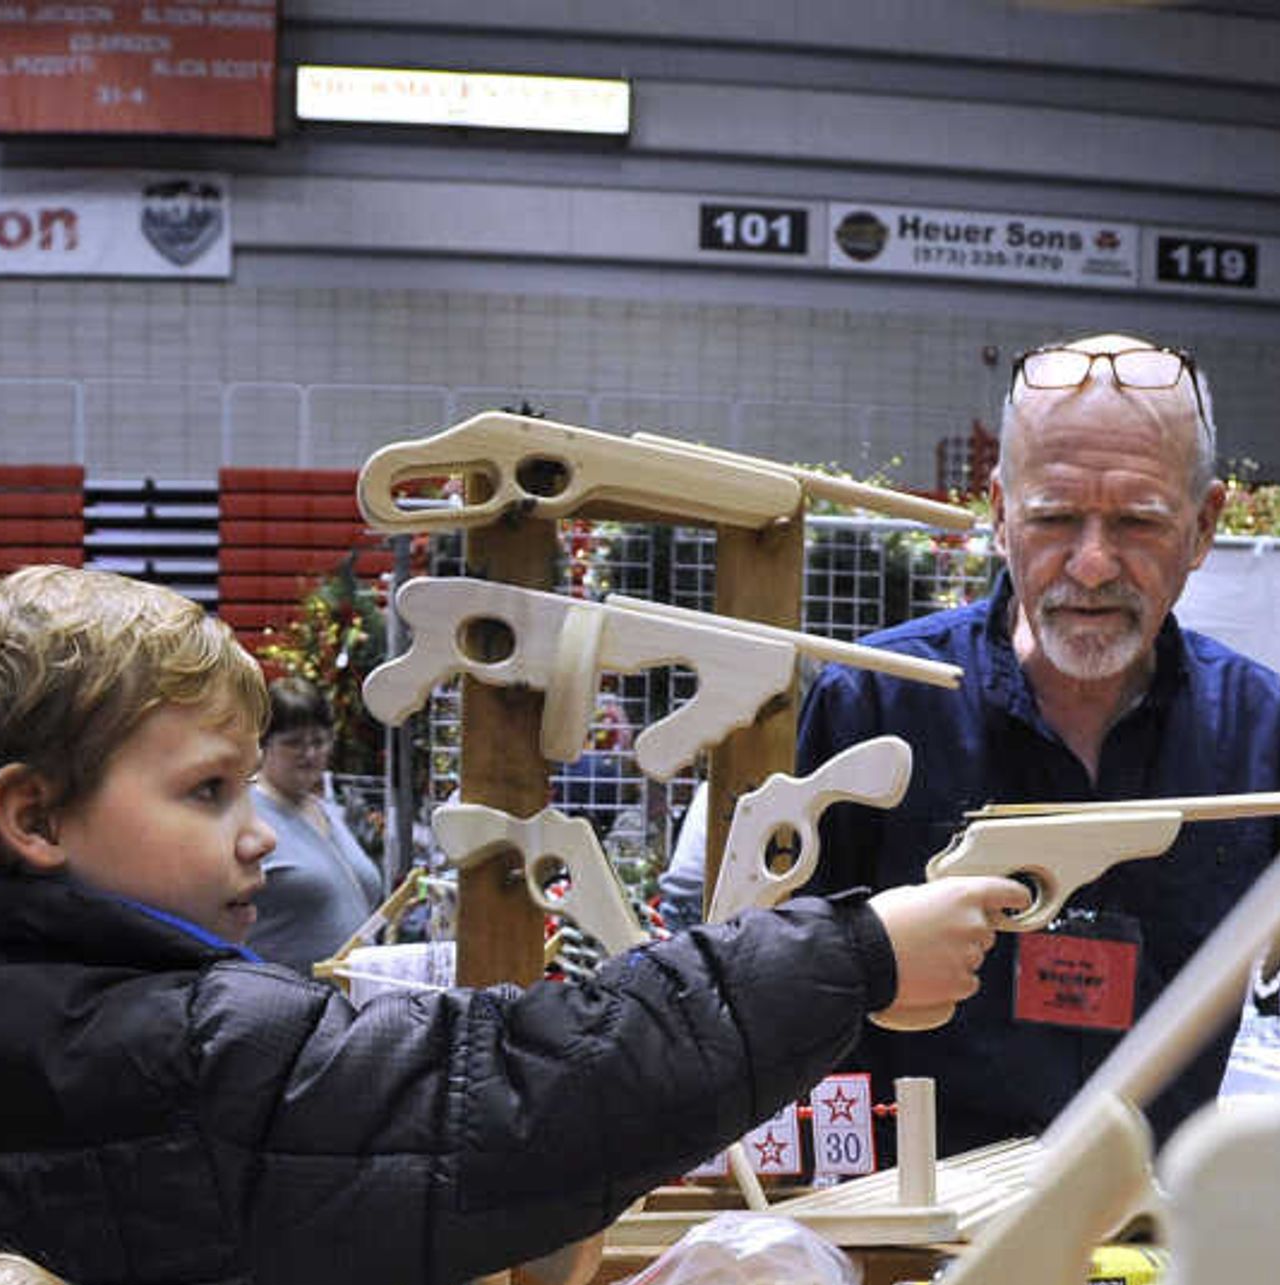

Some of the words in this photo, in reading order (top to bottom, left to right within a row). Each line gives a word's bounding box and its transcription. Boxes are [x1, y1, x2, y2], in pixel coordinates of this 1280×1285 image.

[714, 211, 792, 248] 101
[897, 214, 996, 246] Heuer
[1005, 221, 1084, 252] Sons
[1170, 245, 1248, 281] 119
[826, 1132, 862, 1164] 30
